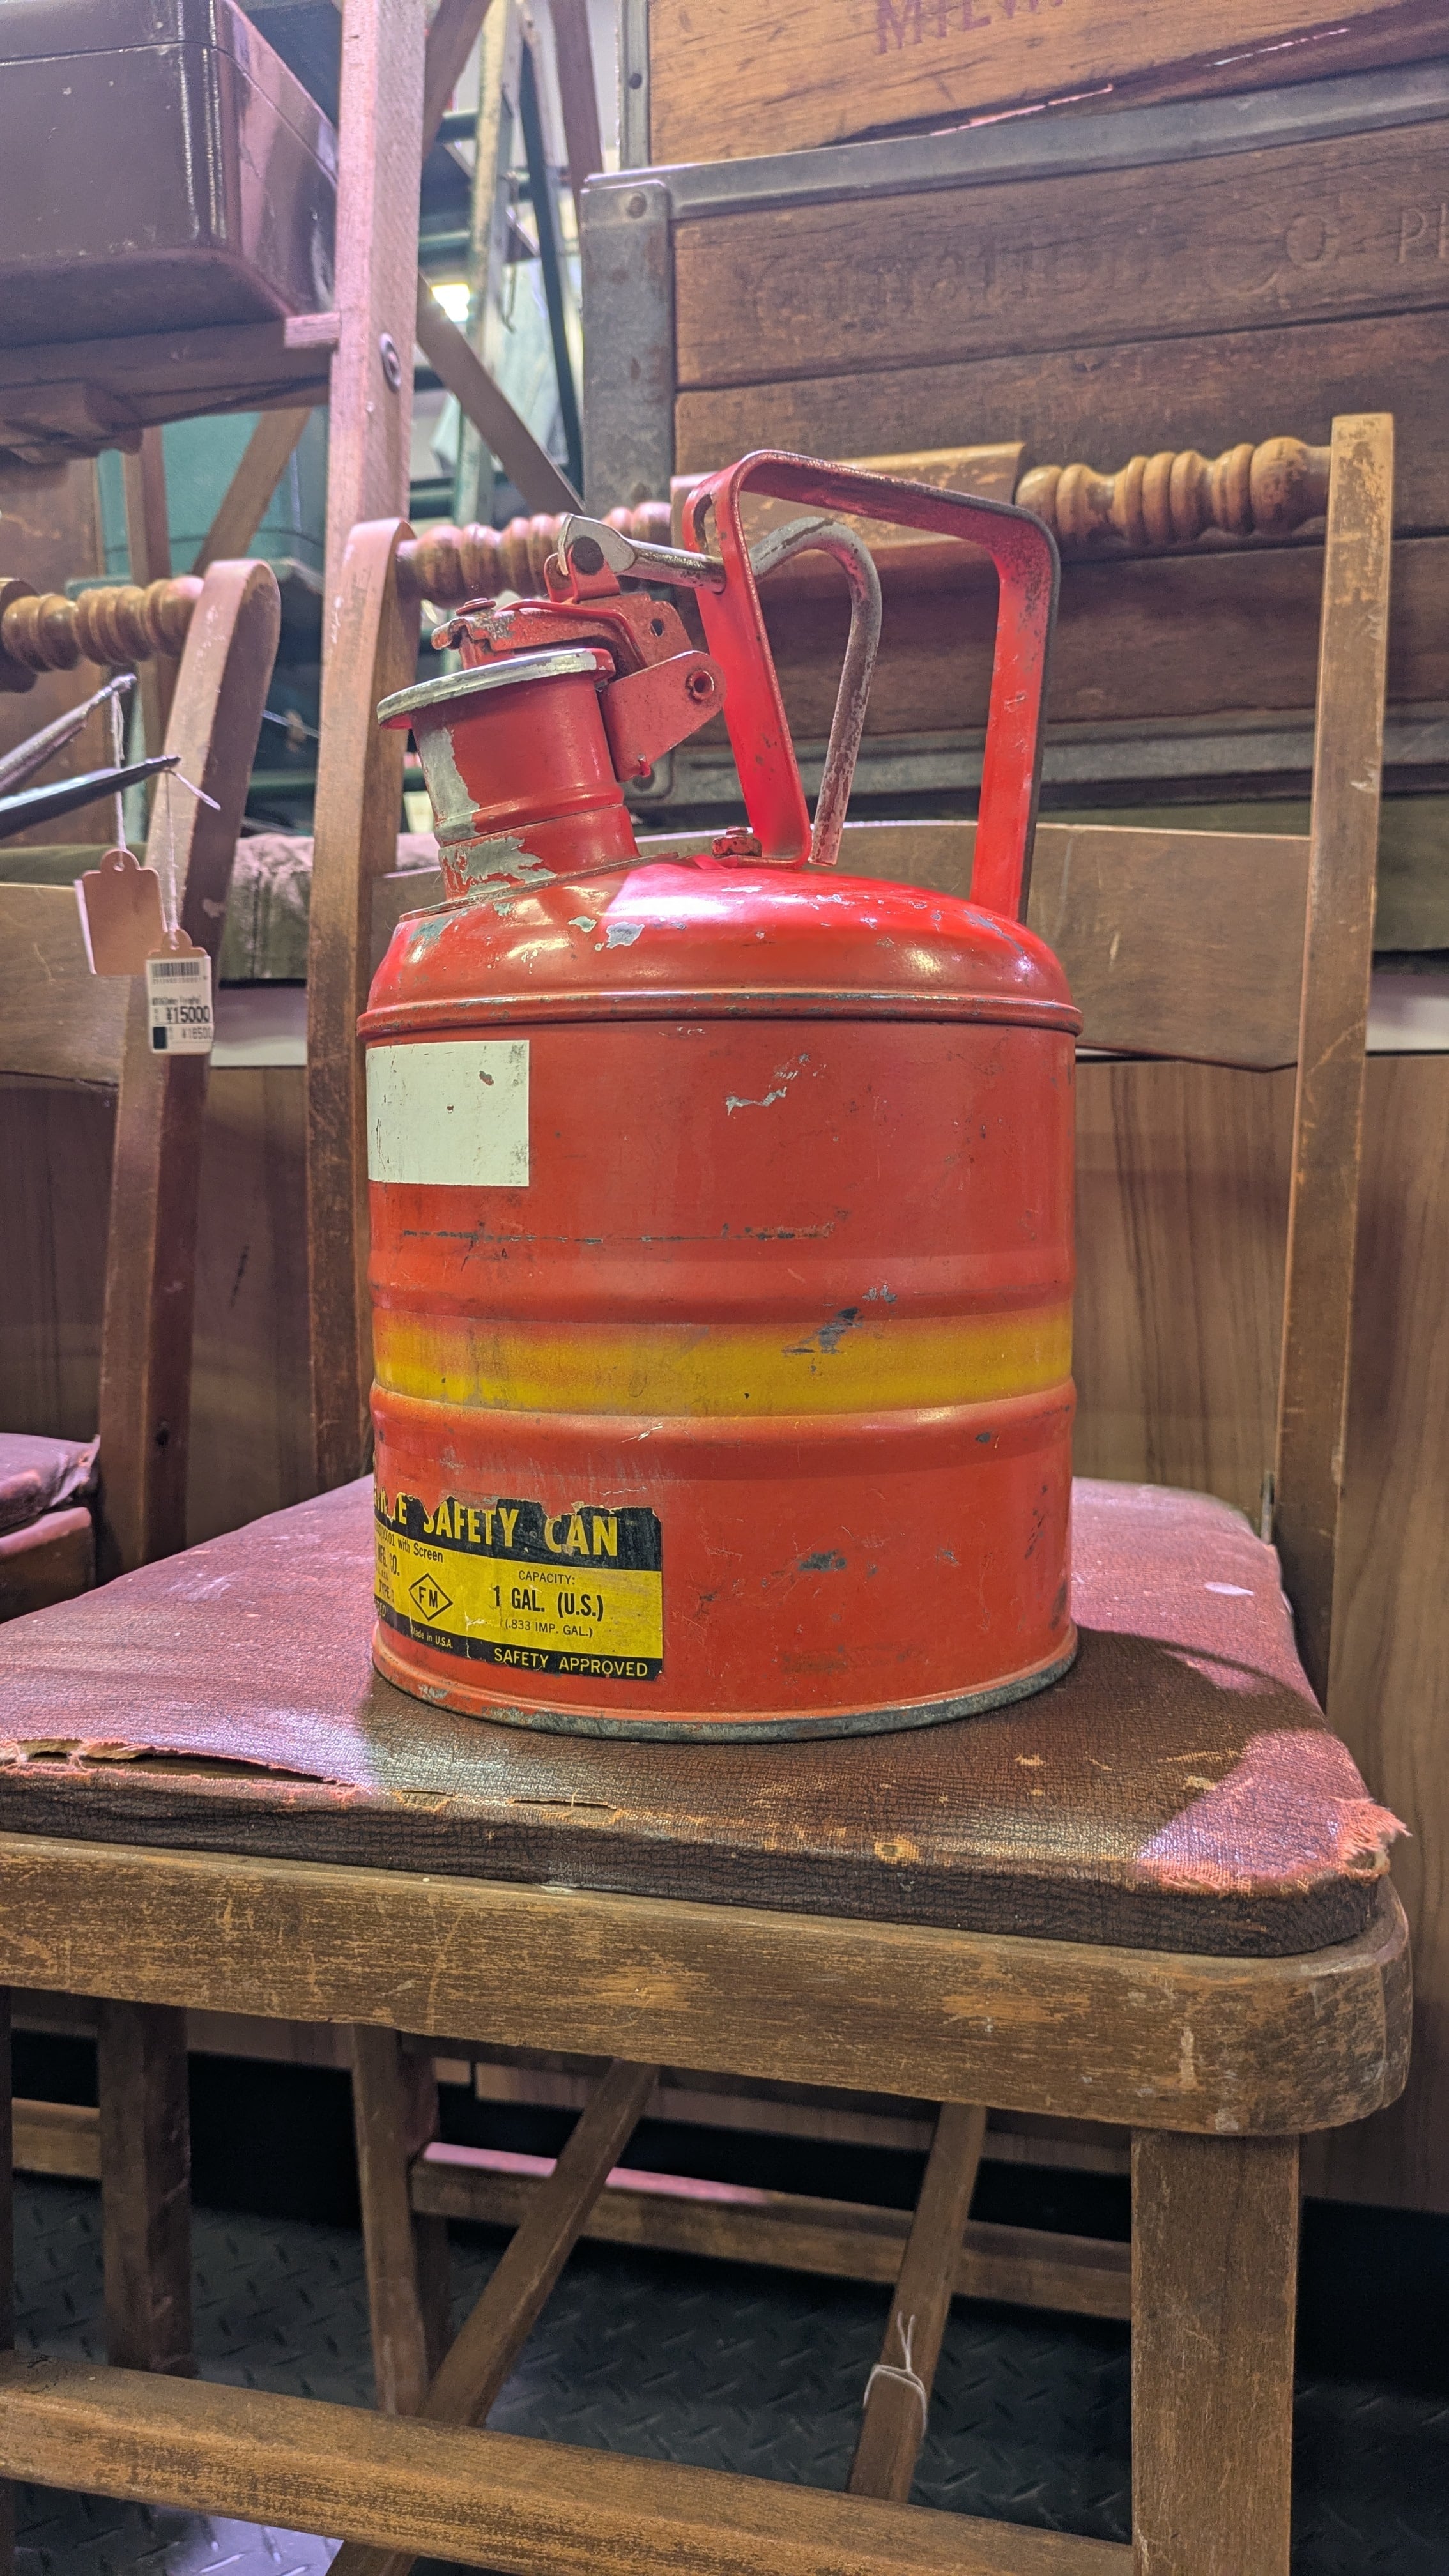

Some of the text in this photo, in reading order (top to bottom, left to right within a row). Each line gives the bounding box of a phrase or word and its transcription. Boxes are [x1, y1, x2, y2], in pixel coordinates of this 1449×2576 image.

[167, 1005, 210, 1023] ¥15000
[545, 1514, 618, 1556] CAN
[398, 1538, 410, 1554] with
[413, 1542, 443, 1563] Screen
[518, 1570, 576, 1585] CAPACITY:
[493, 1585, 604, 1621] 1 GAL. (U.S.)
[505, 1618, 593, 1638] (.833 IMP. GAL.)
[426, 1631, 433, 1642] in
[435, 1635, 454, 1649] U.S.A.
[494, 1647, 648, 1677] SAFETY APPROVED
